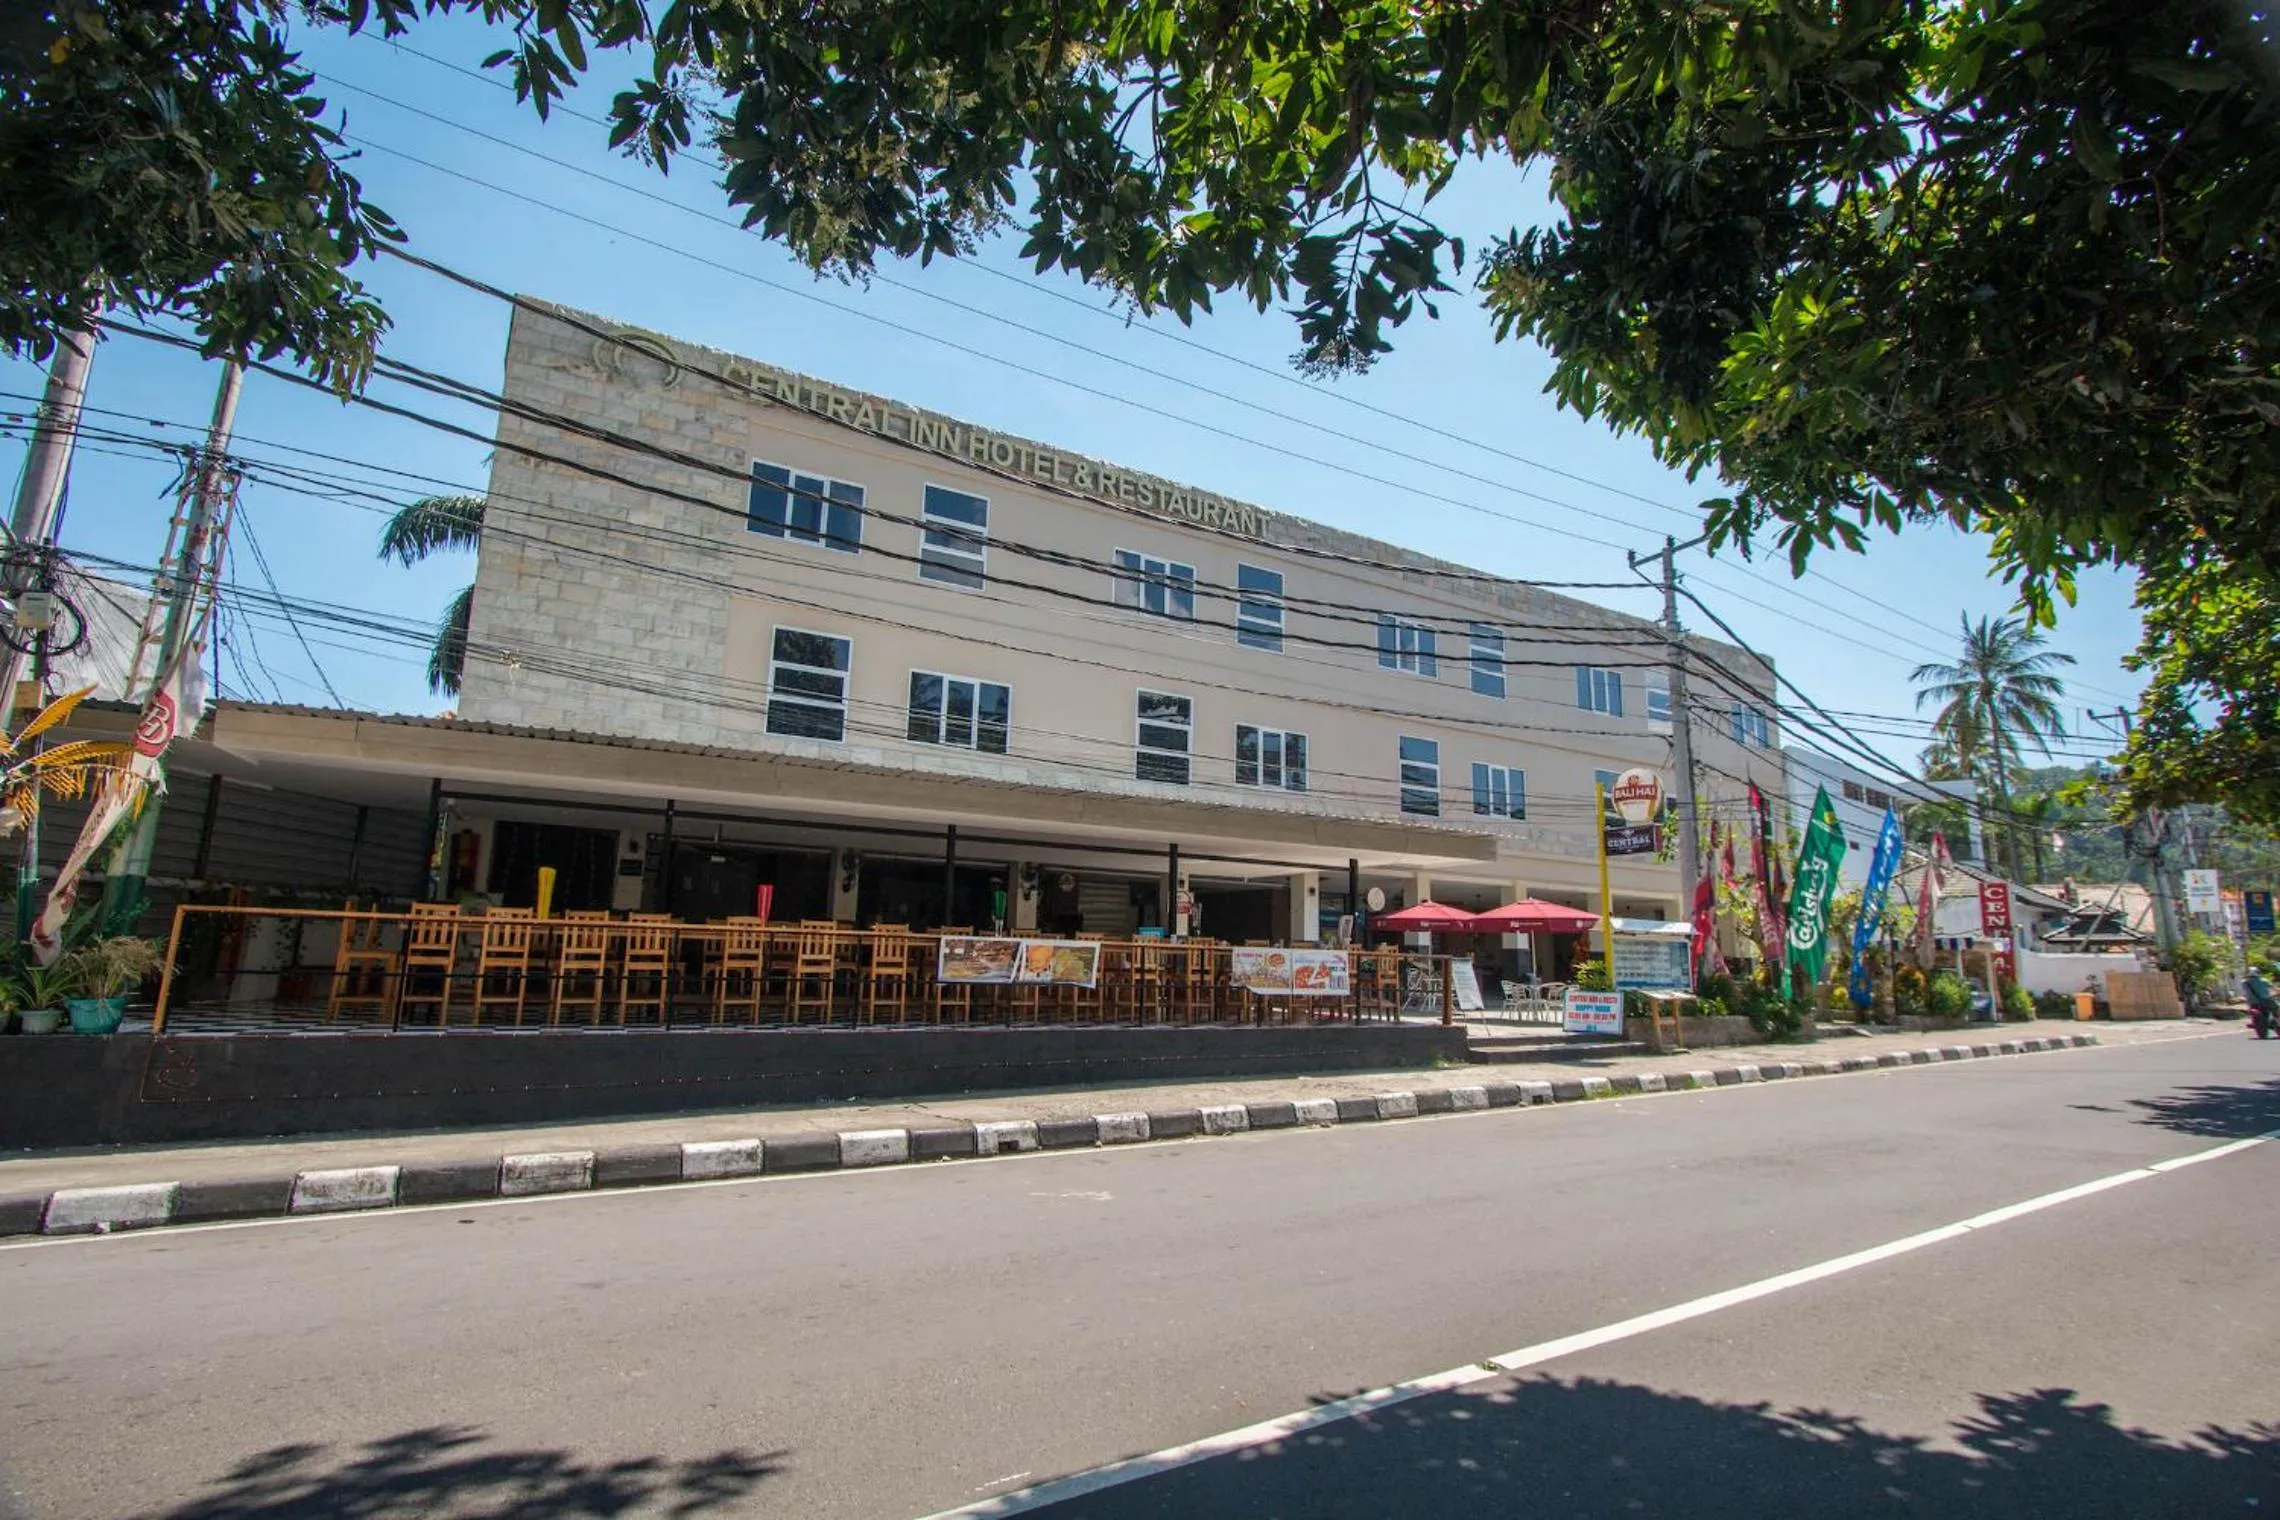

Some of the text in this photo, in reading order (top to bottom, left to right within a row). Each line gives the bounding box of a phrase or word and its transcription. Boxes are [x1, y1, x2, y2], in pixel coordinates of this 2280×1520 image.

[722, 364, 1271, 539] CENTRAL INN HOTEL & RESTAURANT
[1636, 787, 1656, 797] HAI
